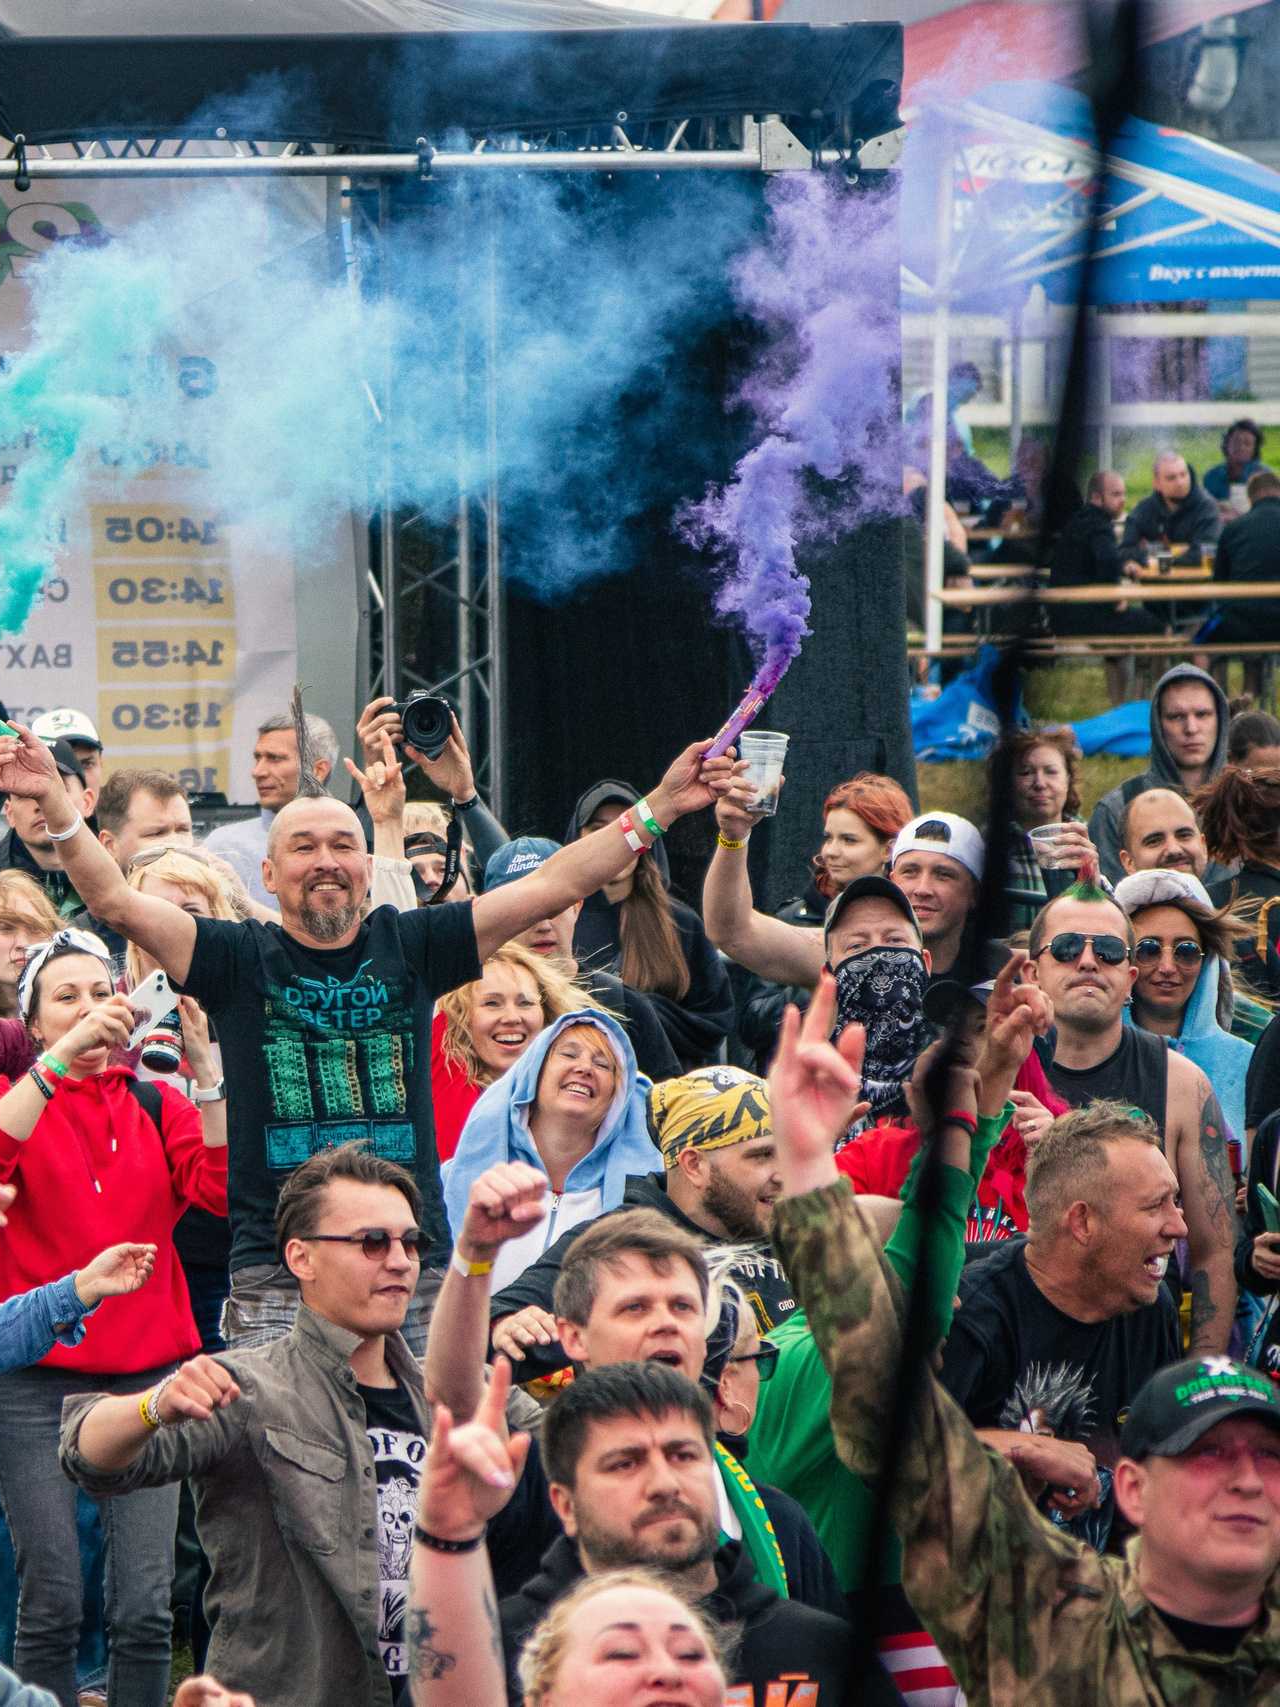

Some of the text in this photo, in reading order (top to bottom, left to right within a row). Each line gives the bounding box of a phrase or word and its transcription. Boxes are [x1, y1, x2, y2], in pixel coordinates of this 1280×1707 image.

[512, 853, 541, 863] Open
[298, 1007, 382, 1029] ВЕТЕР
[778, 1299, 795, 1311] GRD
